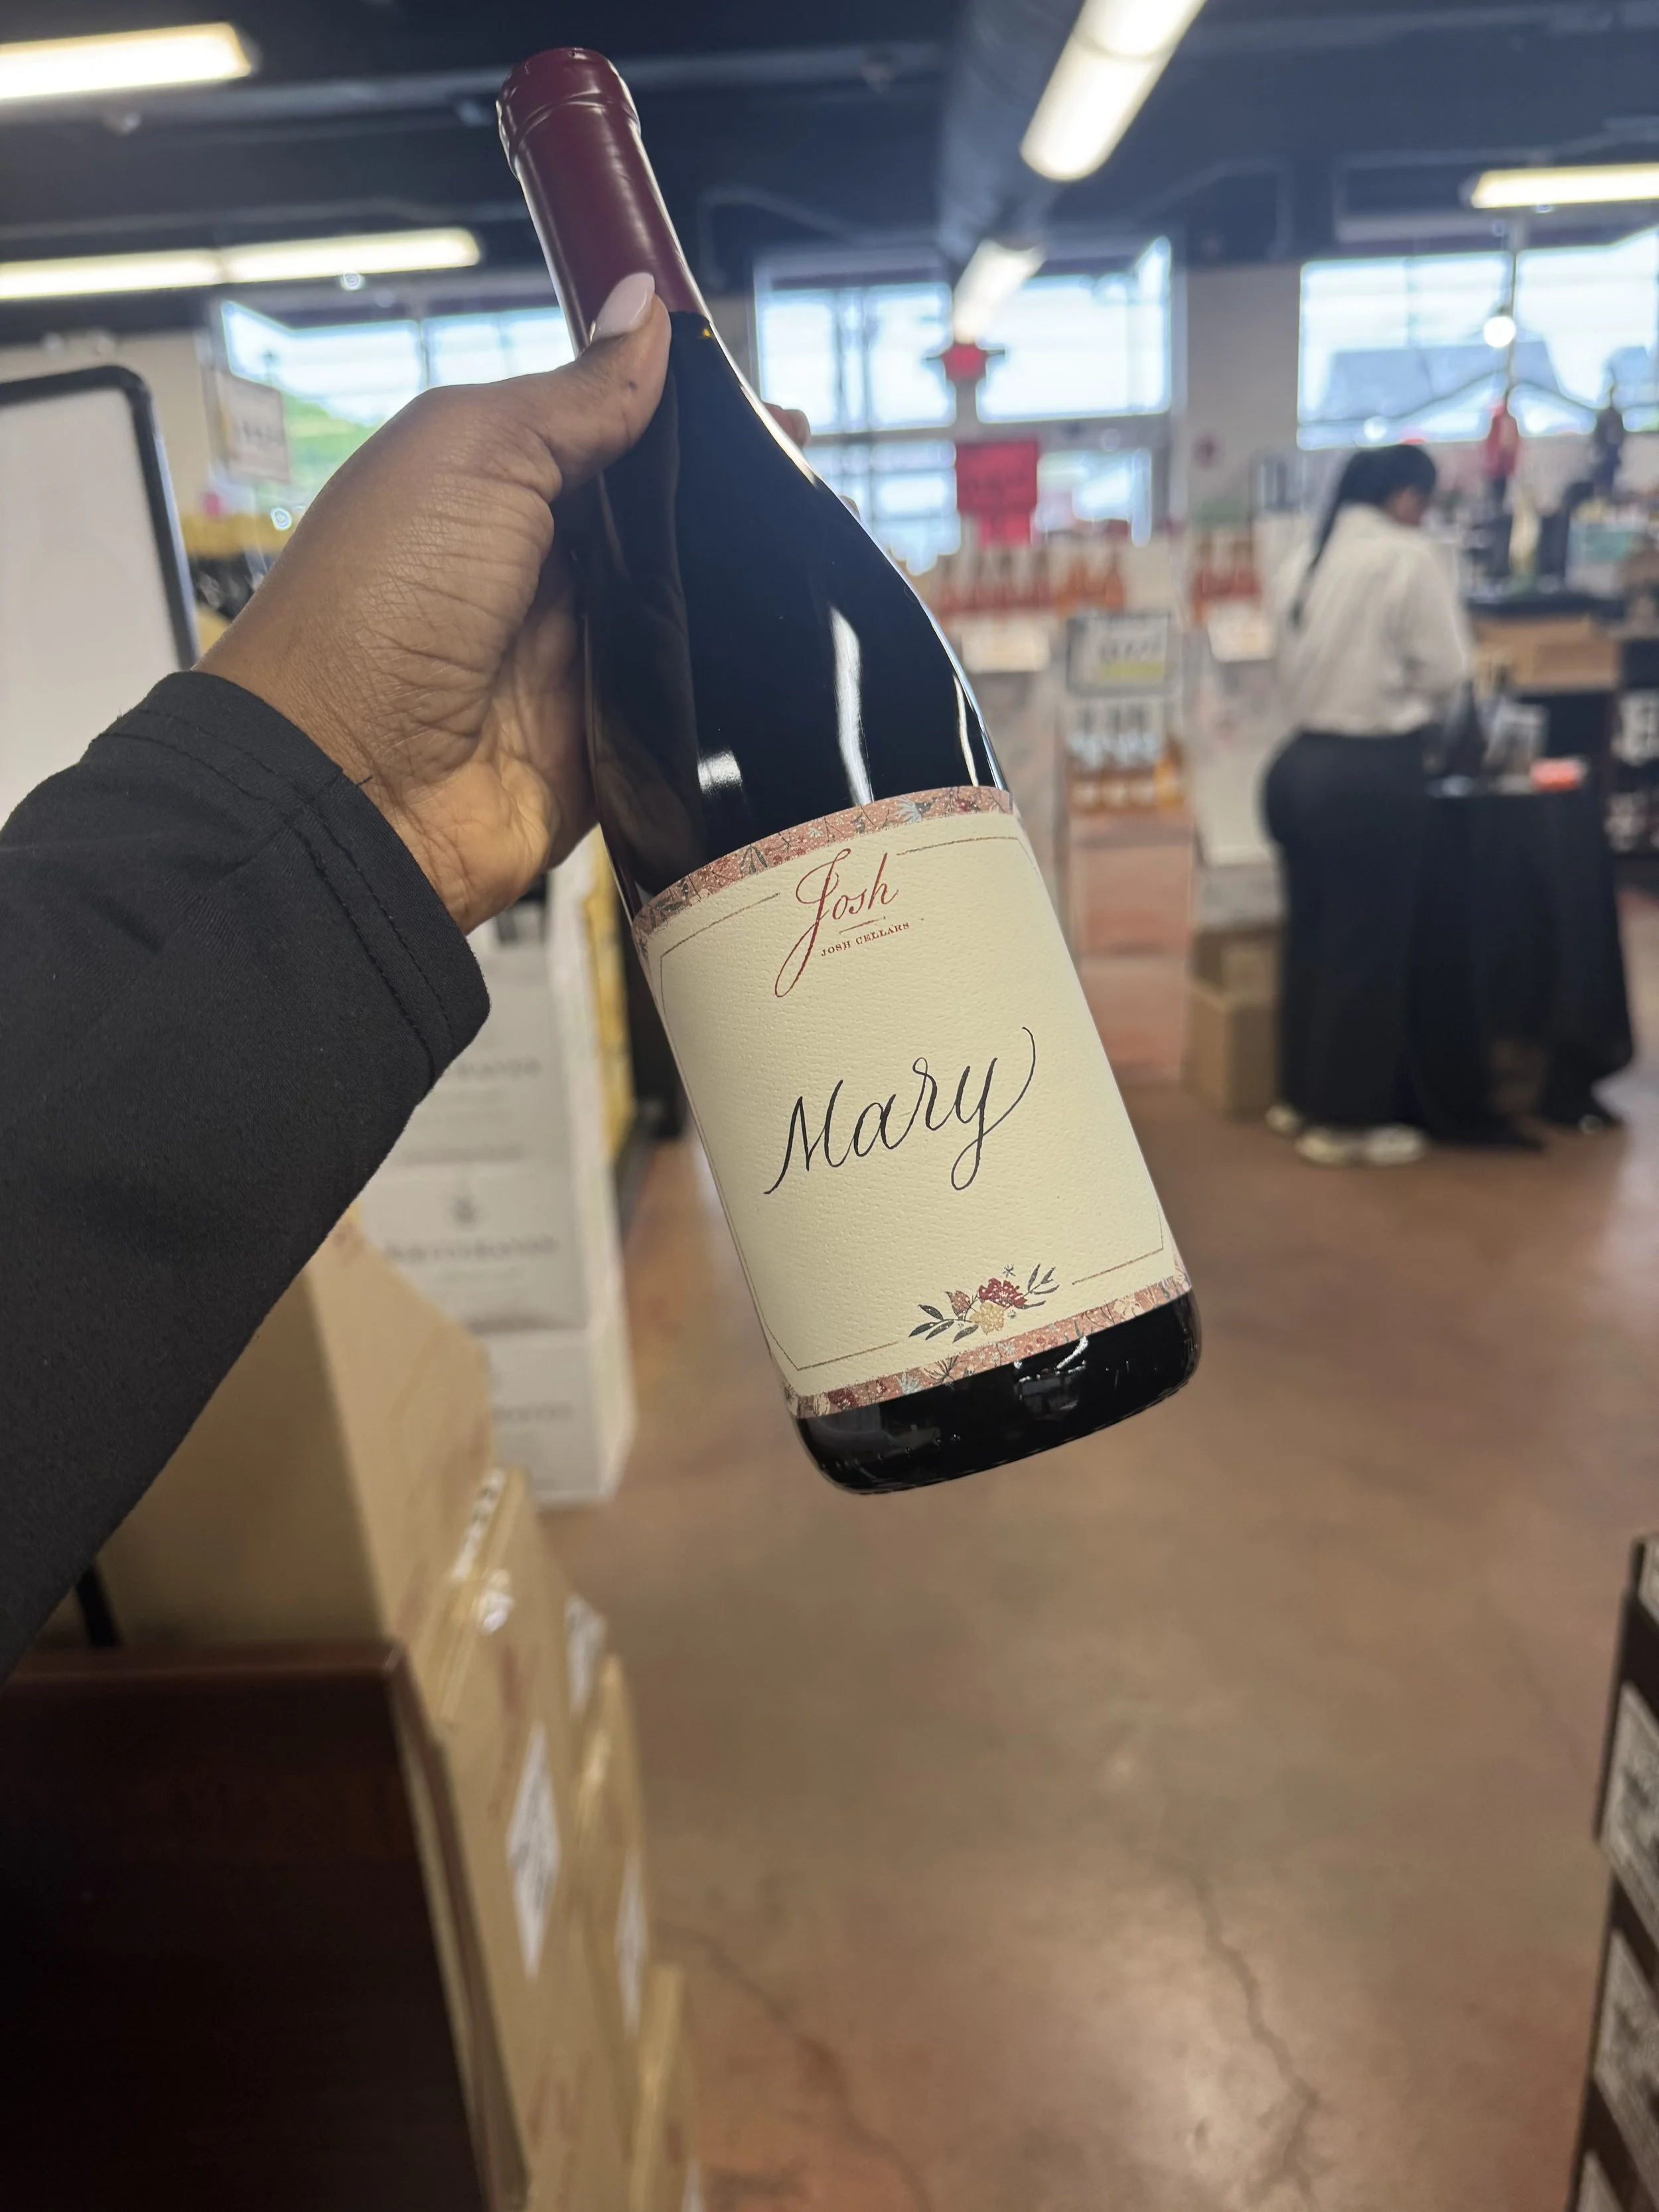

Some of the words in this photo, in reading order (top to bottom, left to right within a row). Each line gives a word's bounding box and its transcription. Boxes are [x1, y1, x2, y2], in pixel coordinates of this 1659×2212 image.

[774, 848, 899, 997] Josh
[822, 940, 851, 956] JOSH
[856, 922, 910, 945] CELLARS
[763, 1026, 1036, 1195] Mary
